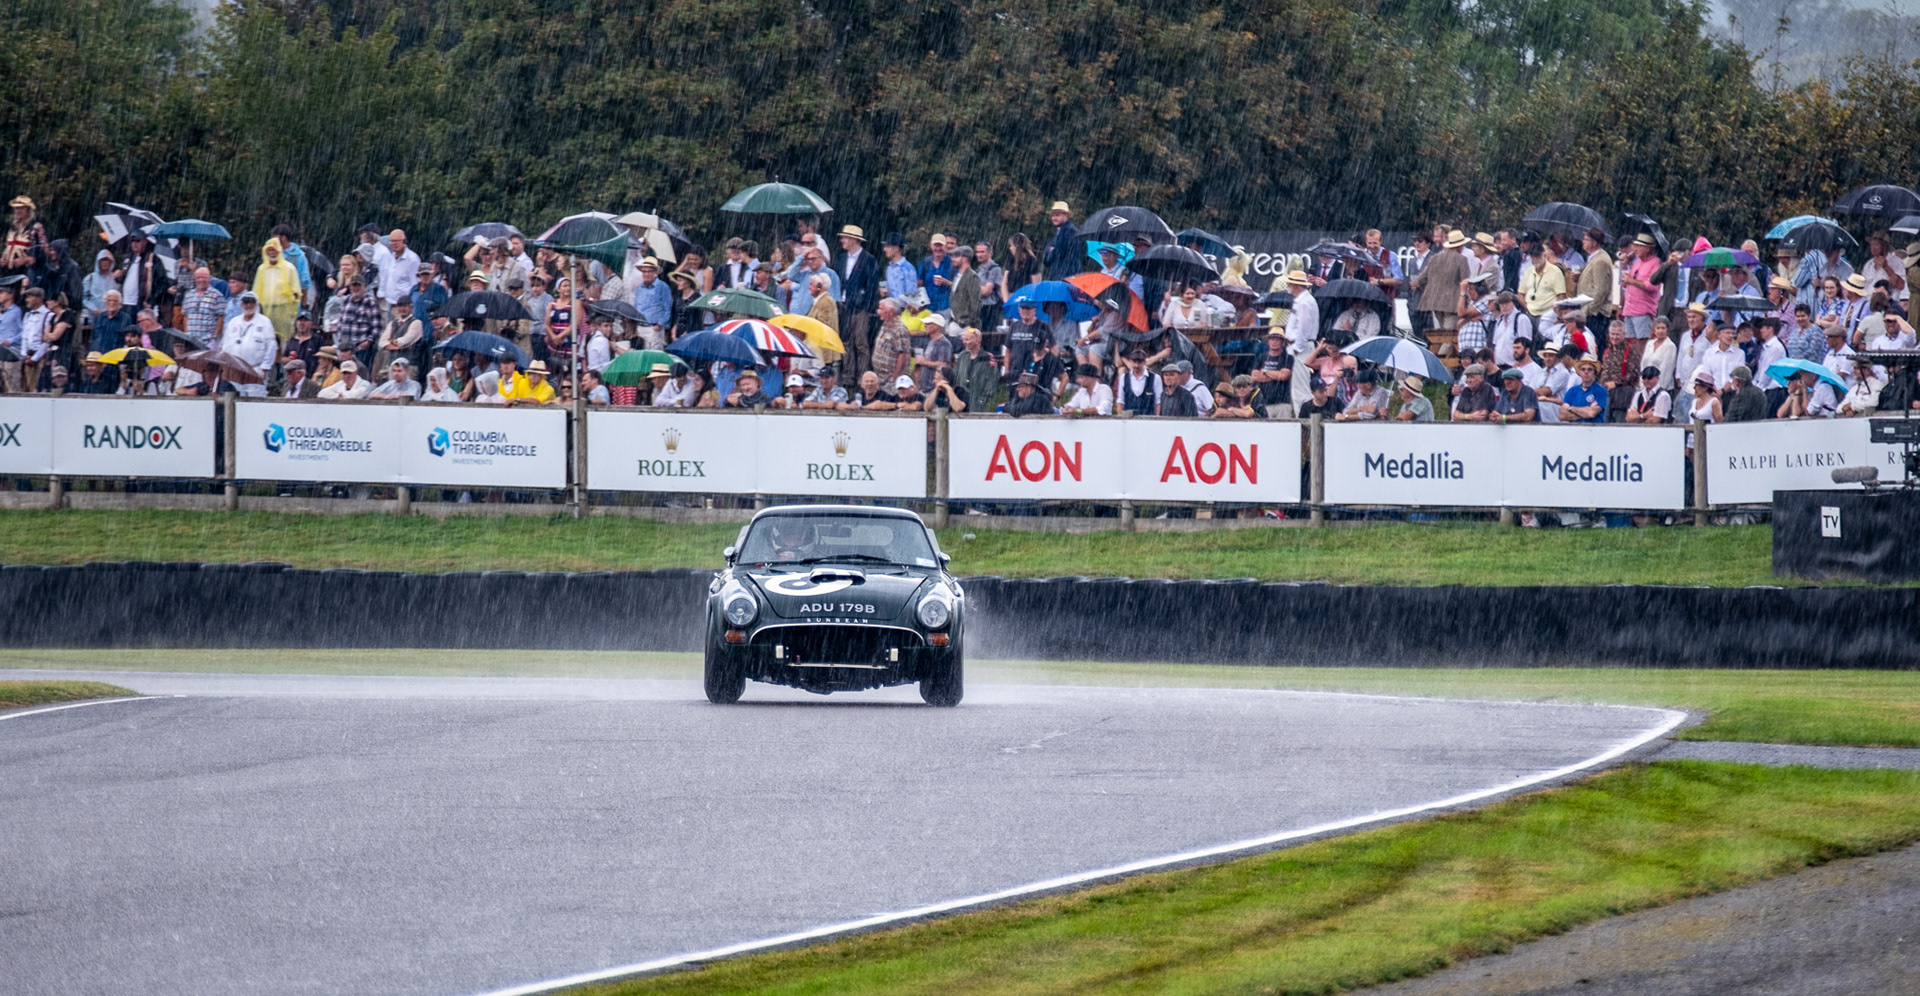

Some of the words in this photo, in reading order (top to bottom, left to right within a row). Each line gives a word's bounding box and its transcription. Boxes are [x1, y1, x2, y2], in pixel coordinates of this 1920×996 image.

[83, 424, 183, 450] RANDOX
[287, 426, 344, 439] COLUMBIA
[452, 430, 508, 443] COLUMBIA
[288, 439, 373, 452] THREADNEEDLE
[452, 443, 537, 457] THREADNEEDLE
[984, 434, 1082, 482] AON
[1159, 436, 1258, 485] AON
[1364, 451, 1464, 480] Medallia
[1728, 455, 1777, 470] RALPH
[1786, 451, 1846, 468] LAUREN
[637, 459, 706, 478] ROLEX
[806, 463, 875, 481] ROLEX
[1541, 454, 1644, 483] Medallia
[1823, 515, 1838, 529] TV
[800, 603, 834, 613] ADU
[839, 603, 876, 614] 179B
